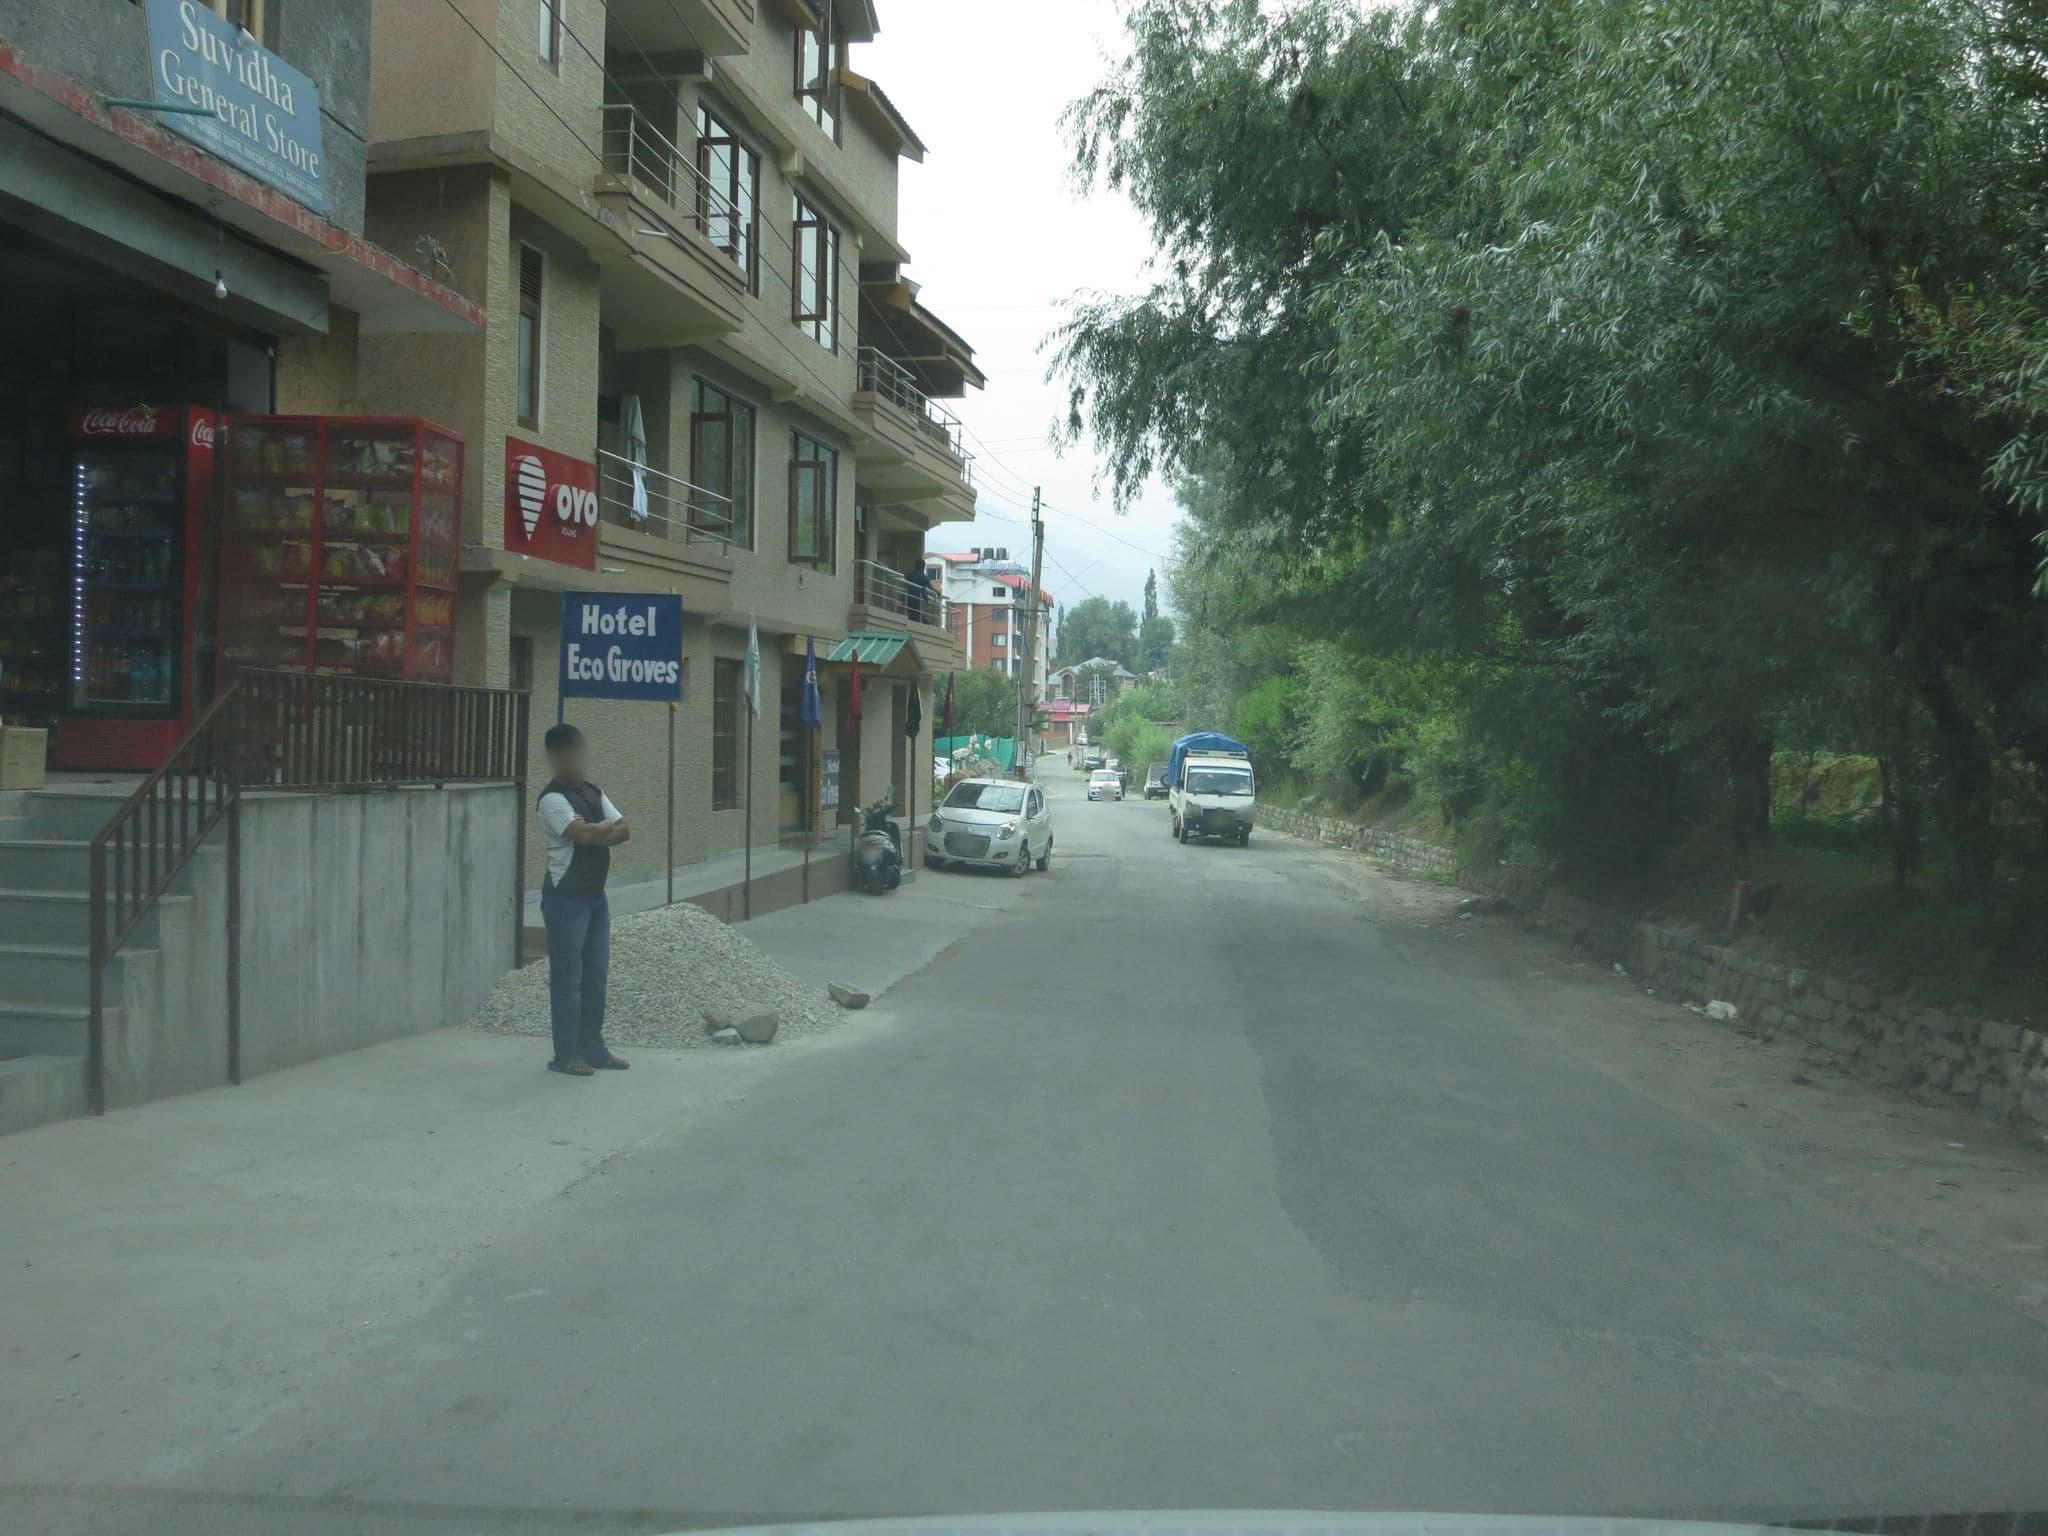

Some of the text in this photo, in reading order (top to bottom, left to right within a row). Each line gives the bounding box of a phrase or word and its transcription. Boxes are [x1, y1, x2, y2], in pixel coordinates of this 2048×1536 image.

[179, 0, 296, 117] Suvidha
[160, 49, 260, 143] General
[265, 113, 321, 179] Store
[556, 484, 599, 528] OYO
[582, 604, 657, 637] Hotel
[567, 643, 680, 684] Eco Groves
